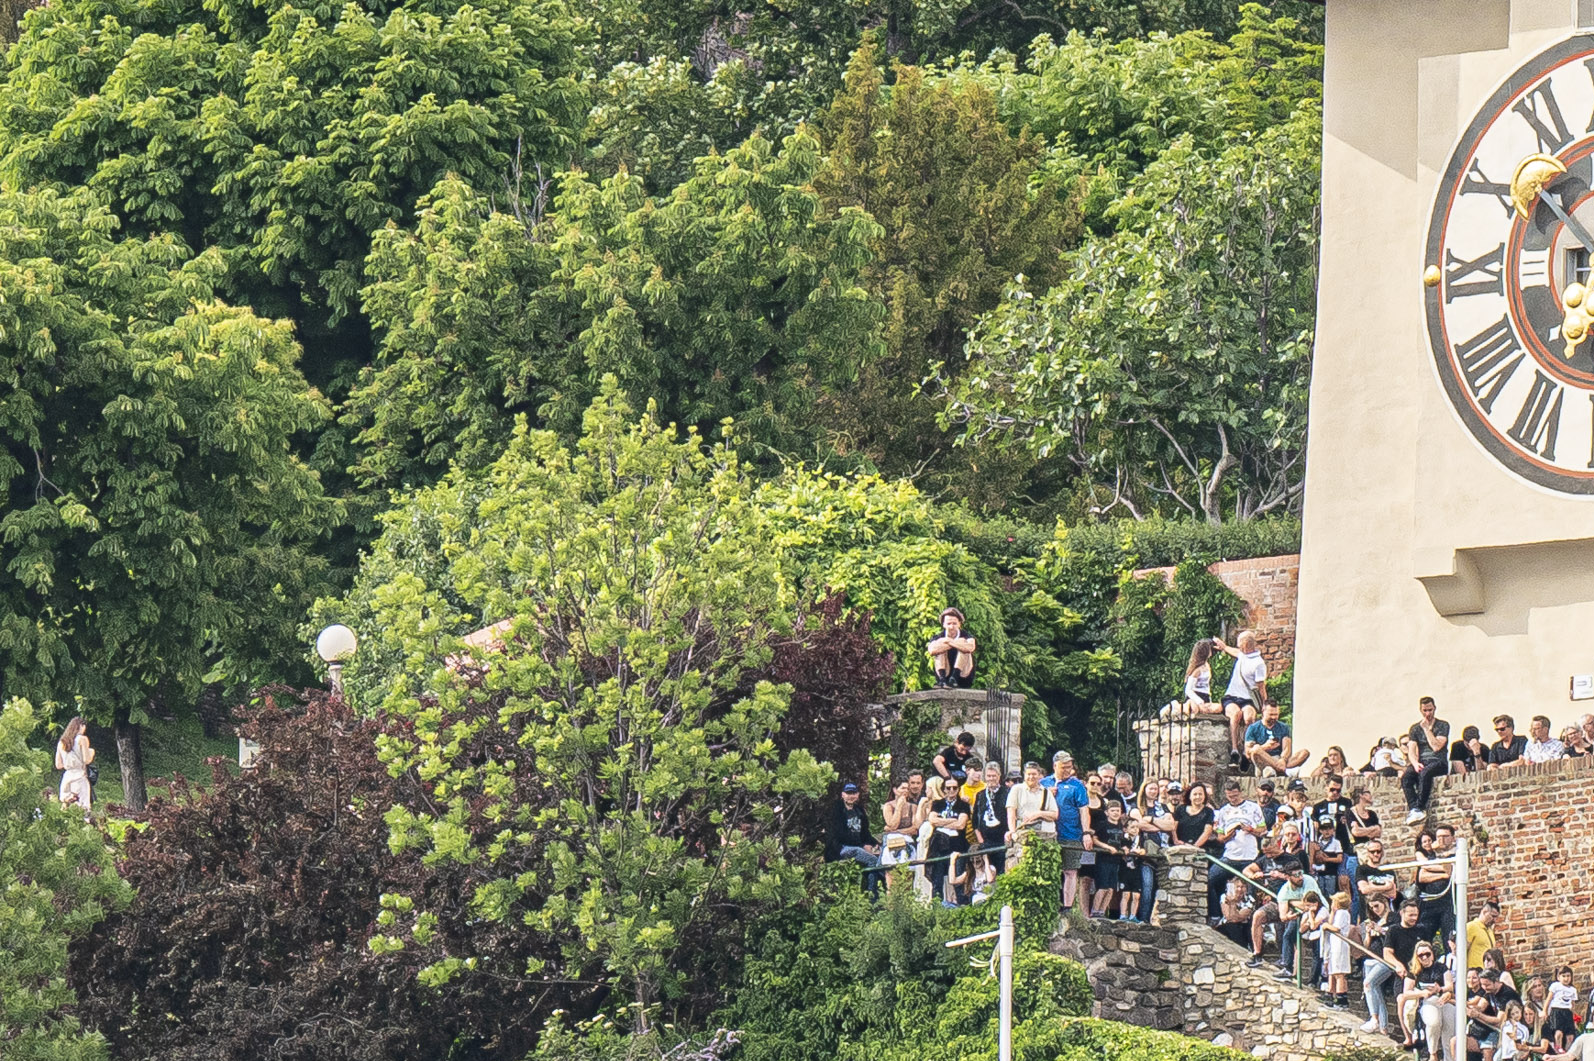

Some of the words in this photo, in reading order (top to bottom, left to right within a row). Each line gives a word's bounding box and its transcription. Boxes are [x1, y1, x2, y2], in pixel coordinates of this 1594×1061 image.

[1512, 77, 1575, 158] XI
[1459, 157, 1515, 219] X
[1446, 242, 1505, 304] IX
[1454, 312, 1526, 415] VIII
[1506, 369, 1564, 461] VII
